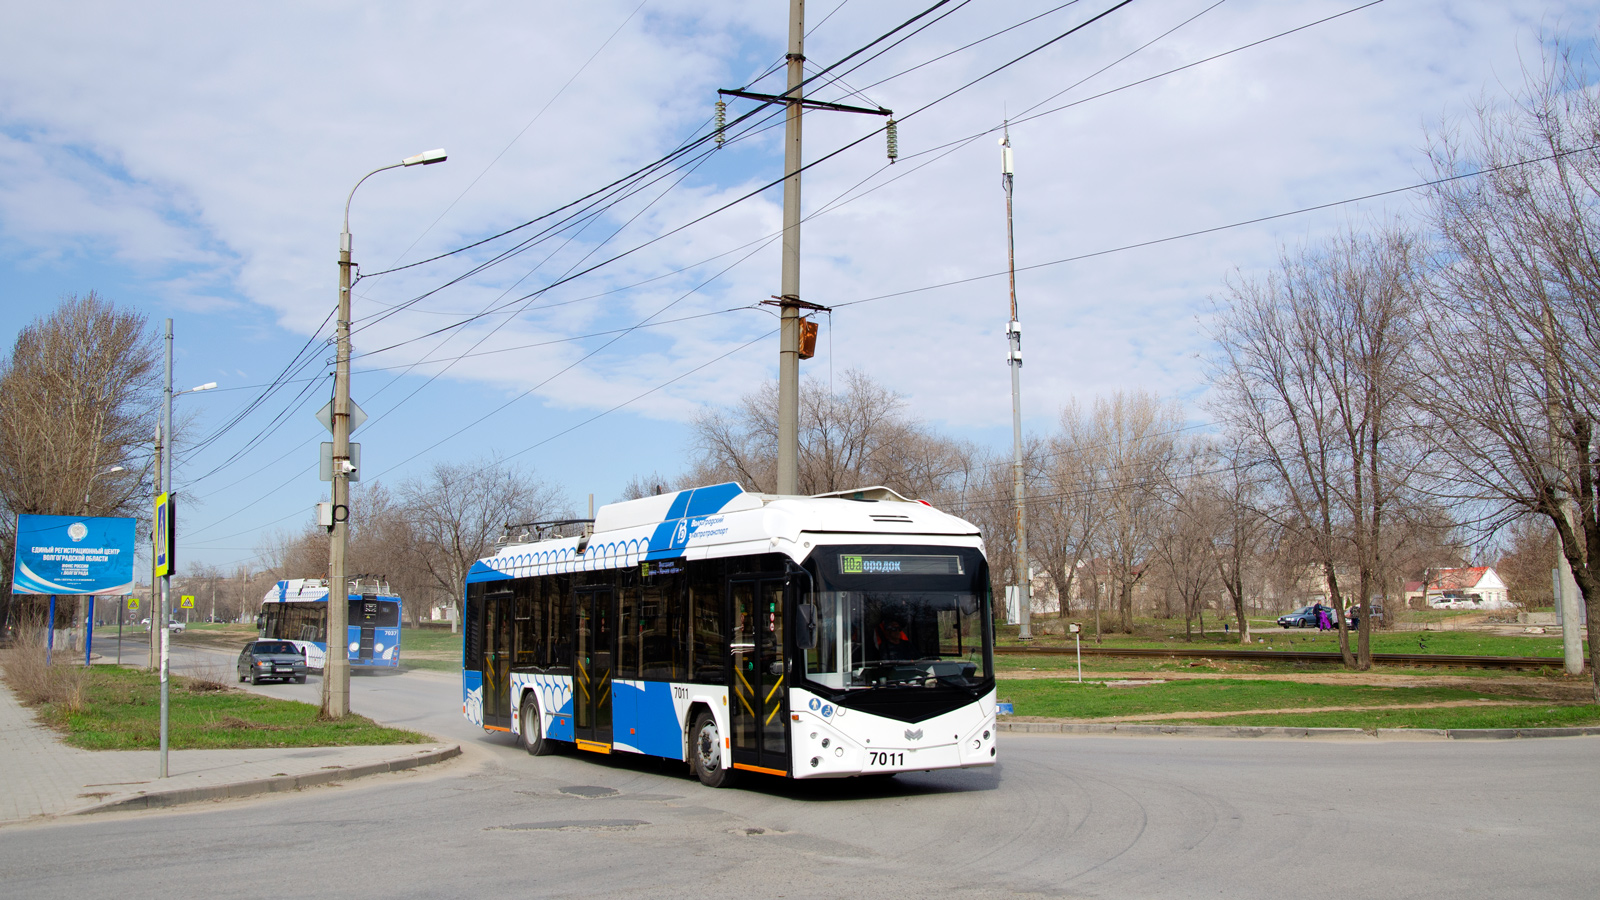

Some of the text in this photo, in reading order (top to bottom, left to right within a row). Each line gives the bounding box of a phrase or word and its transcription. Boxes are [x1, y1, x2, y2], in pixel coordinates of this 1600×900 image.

[54, 547, 103, 555] РЕГИСТРАЦИОННЫЙ
[43, 554, 85, 562] ВОЛГОГРАДСКОЙ
[673, 686, 689, 700] 7011
[869, 751, 904, 766] 7011
